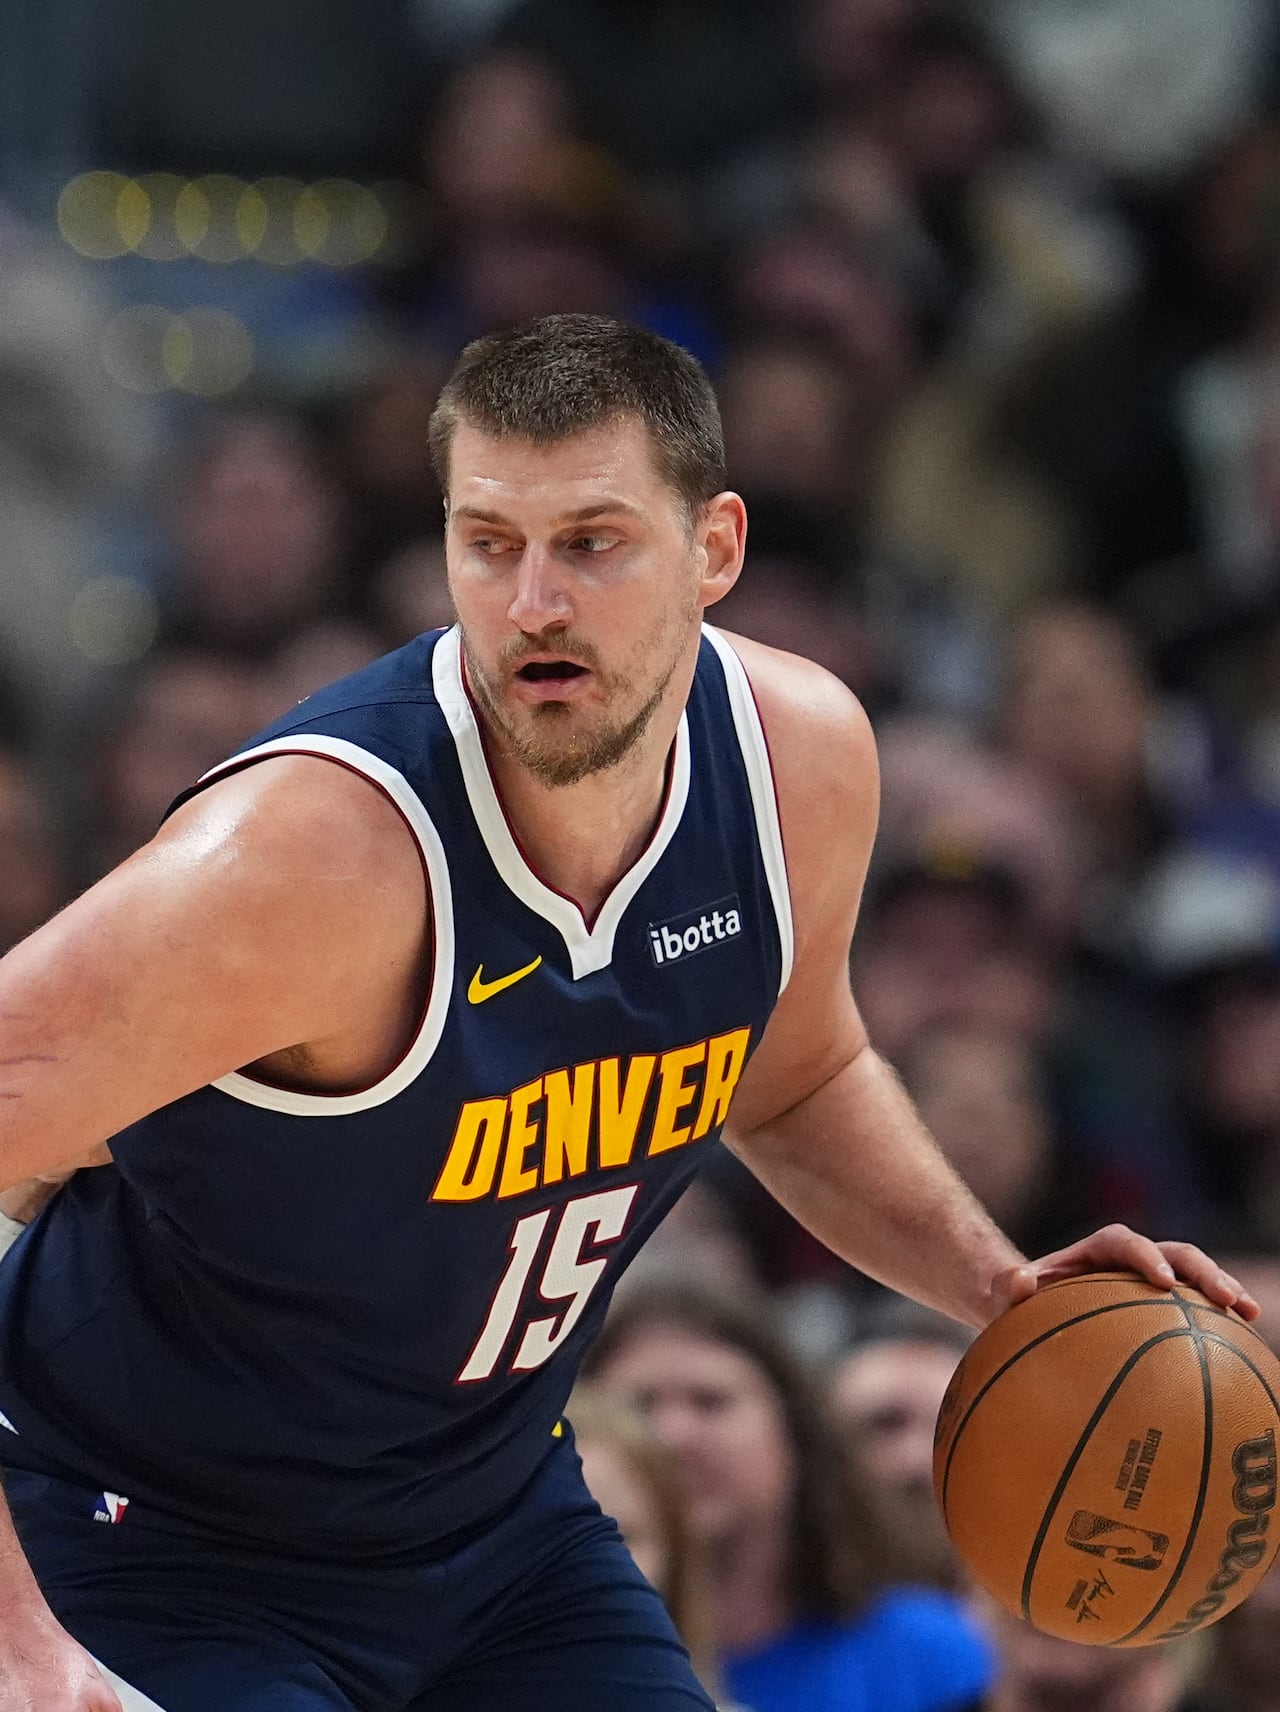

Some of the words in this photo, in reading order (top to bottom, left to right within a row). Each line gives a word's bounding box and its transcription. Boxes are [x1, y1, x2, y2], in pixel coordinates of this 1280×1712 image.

[650, 909, 741, 963] ibotta
[428, 1025, 751, 1203] DENVER
[452, 1181, 643, 1385] 15
